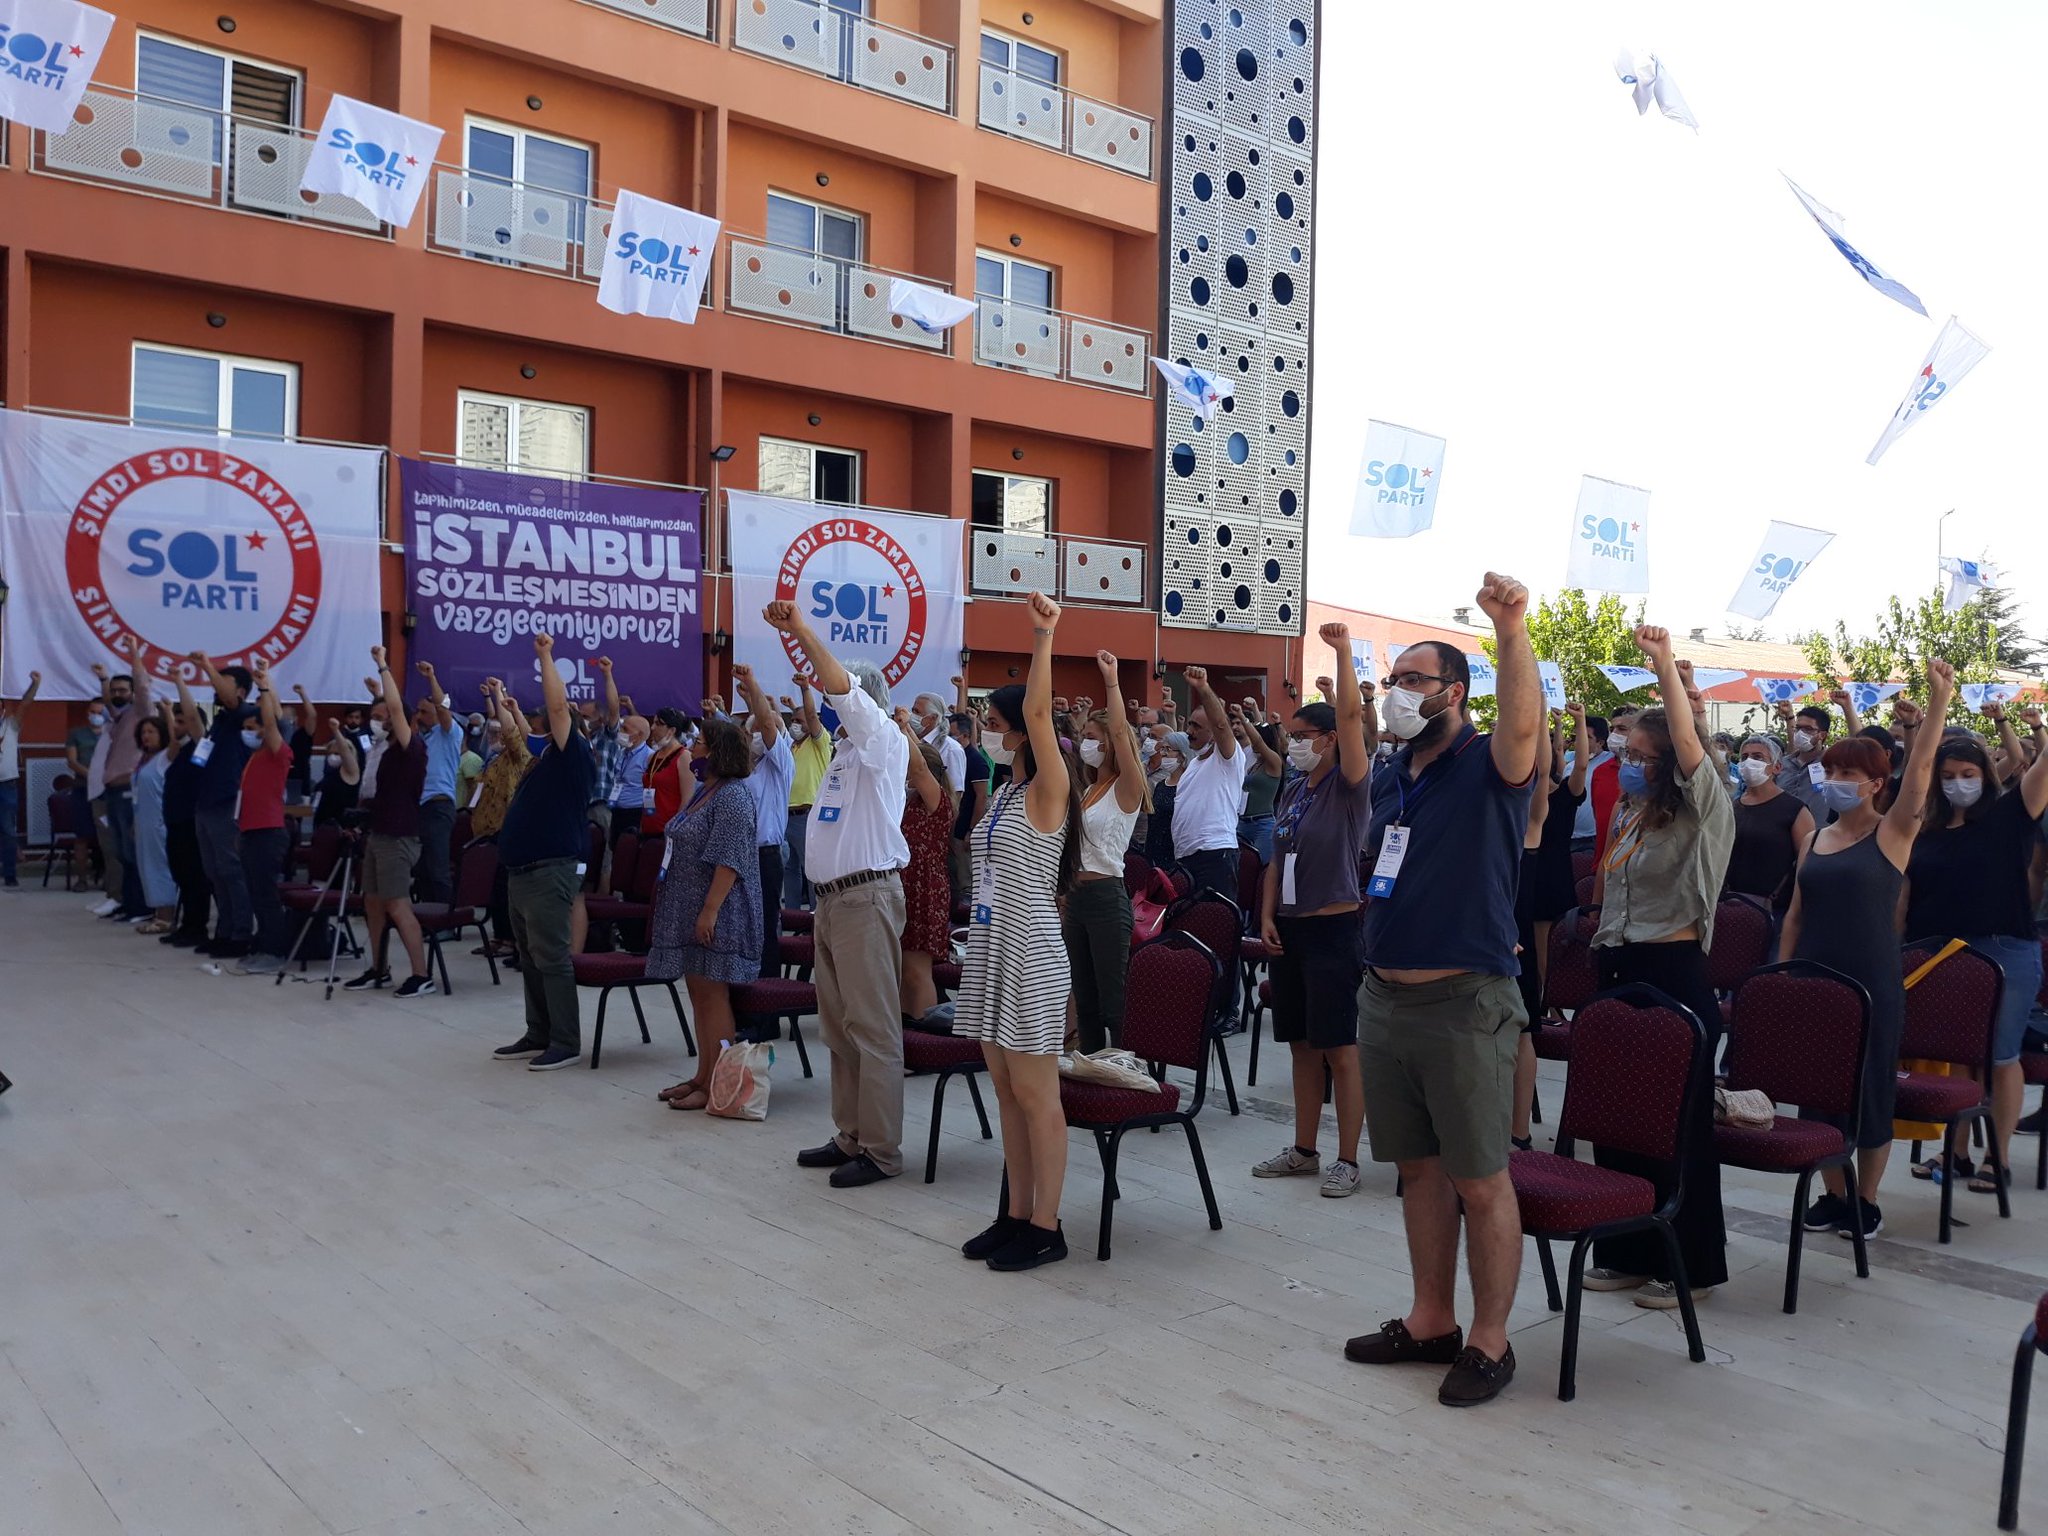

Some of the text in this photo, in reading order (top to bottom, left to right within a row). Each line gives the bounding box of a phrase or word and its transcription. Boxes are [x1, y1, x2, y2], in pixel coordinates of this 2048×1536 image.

[328, 128, 406, 179] SOL
[615, 232, 690, 271] SOL
[1365, 460, 1425, 493] SOL
[148, 451, 209, 475] SOL
[220, 458, 313, 551] ZAMANI
[1580, 514, 1634, 547] SOL
[127, 528, 258, 582] SOL
[821, 522, 858, 540] SOL
[867, 528, 923, 597] ZAMANI
[810, 580, 888, 623] SOL
[1760, 577, 1791, 594] PAR
[887, 631, 921, 682] MANI
[1352, 656, 1369, 669] OL
[1470, 664, 1490, 674] OL
